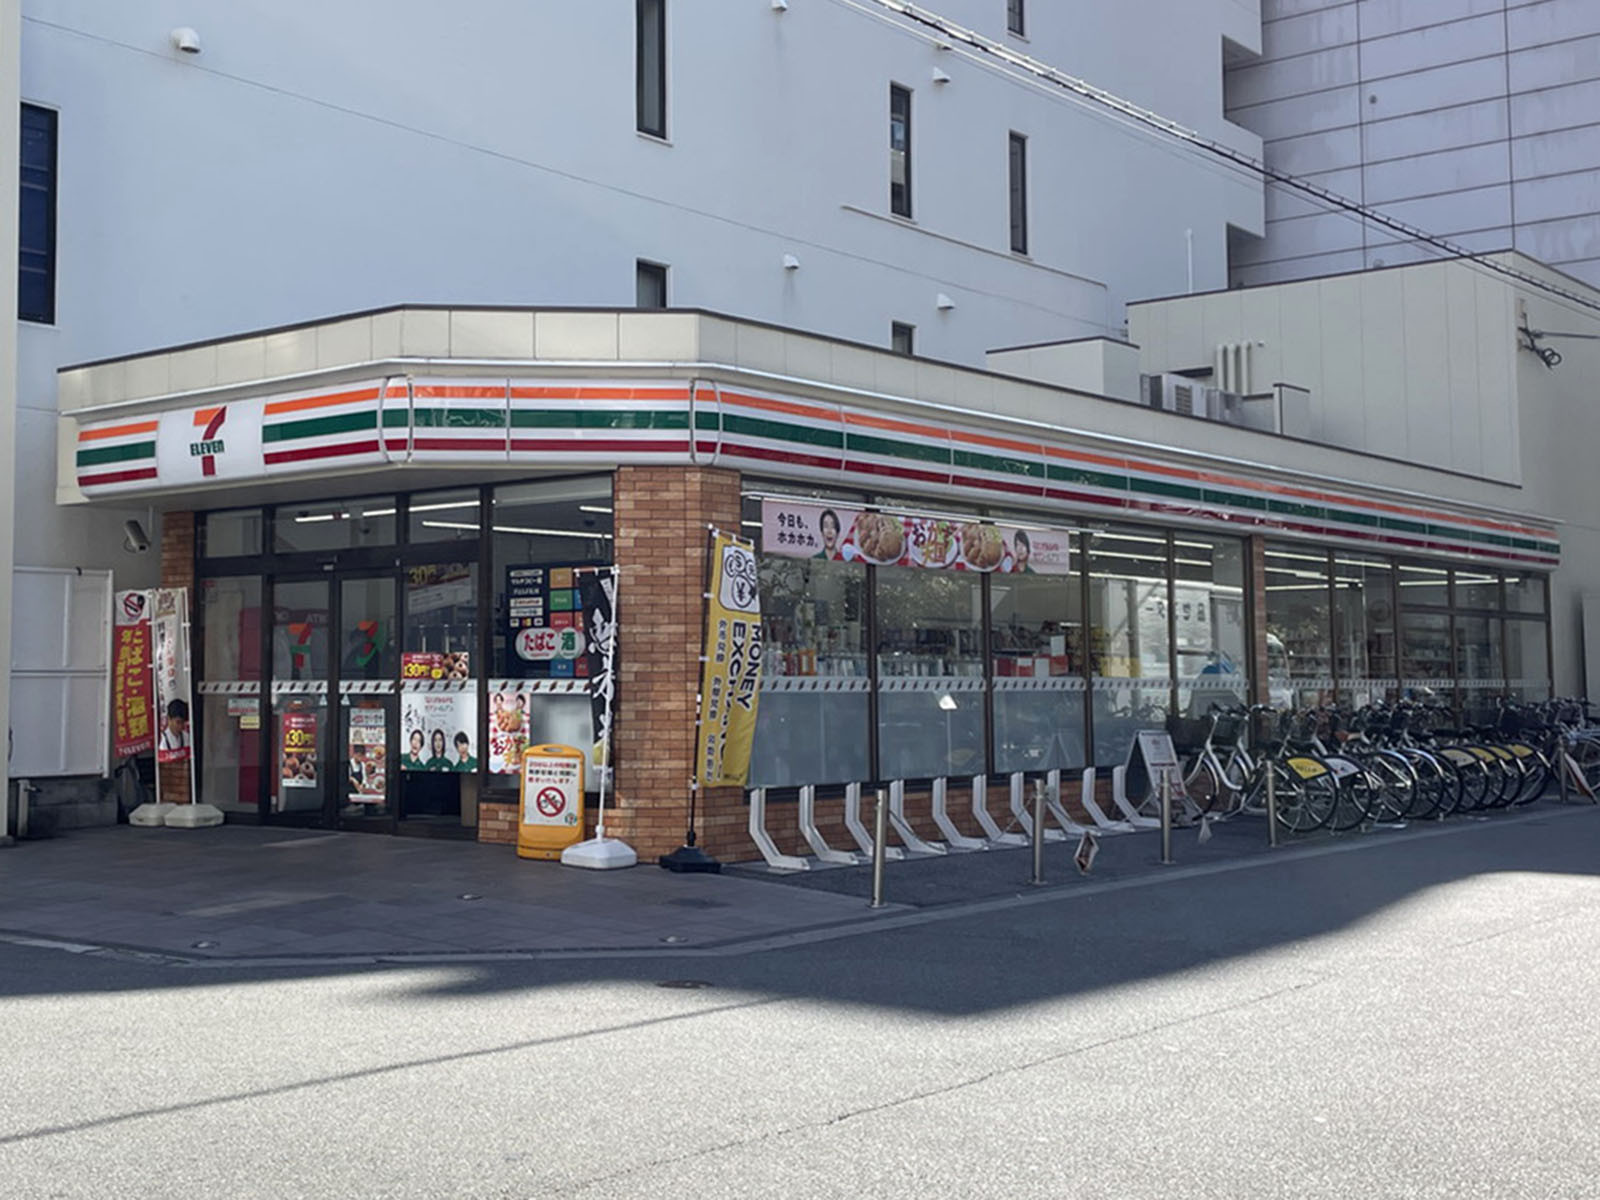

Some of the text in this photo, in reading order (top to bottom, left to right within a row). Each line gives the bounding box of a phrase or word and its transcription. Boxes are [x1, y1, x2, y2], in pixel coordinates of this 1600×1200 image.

[777, 512, 809, 530] 今日も、
[524, 631, 556, 651] たばこ
[561, 631, 576, 651] 酒
[737, 623, 761, 709] MONEY
